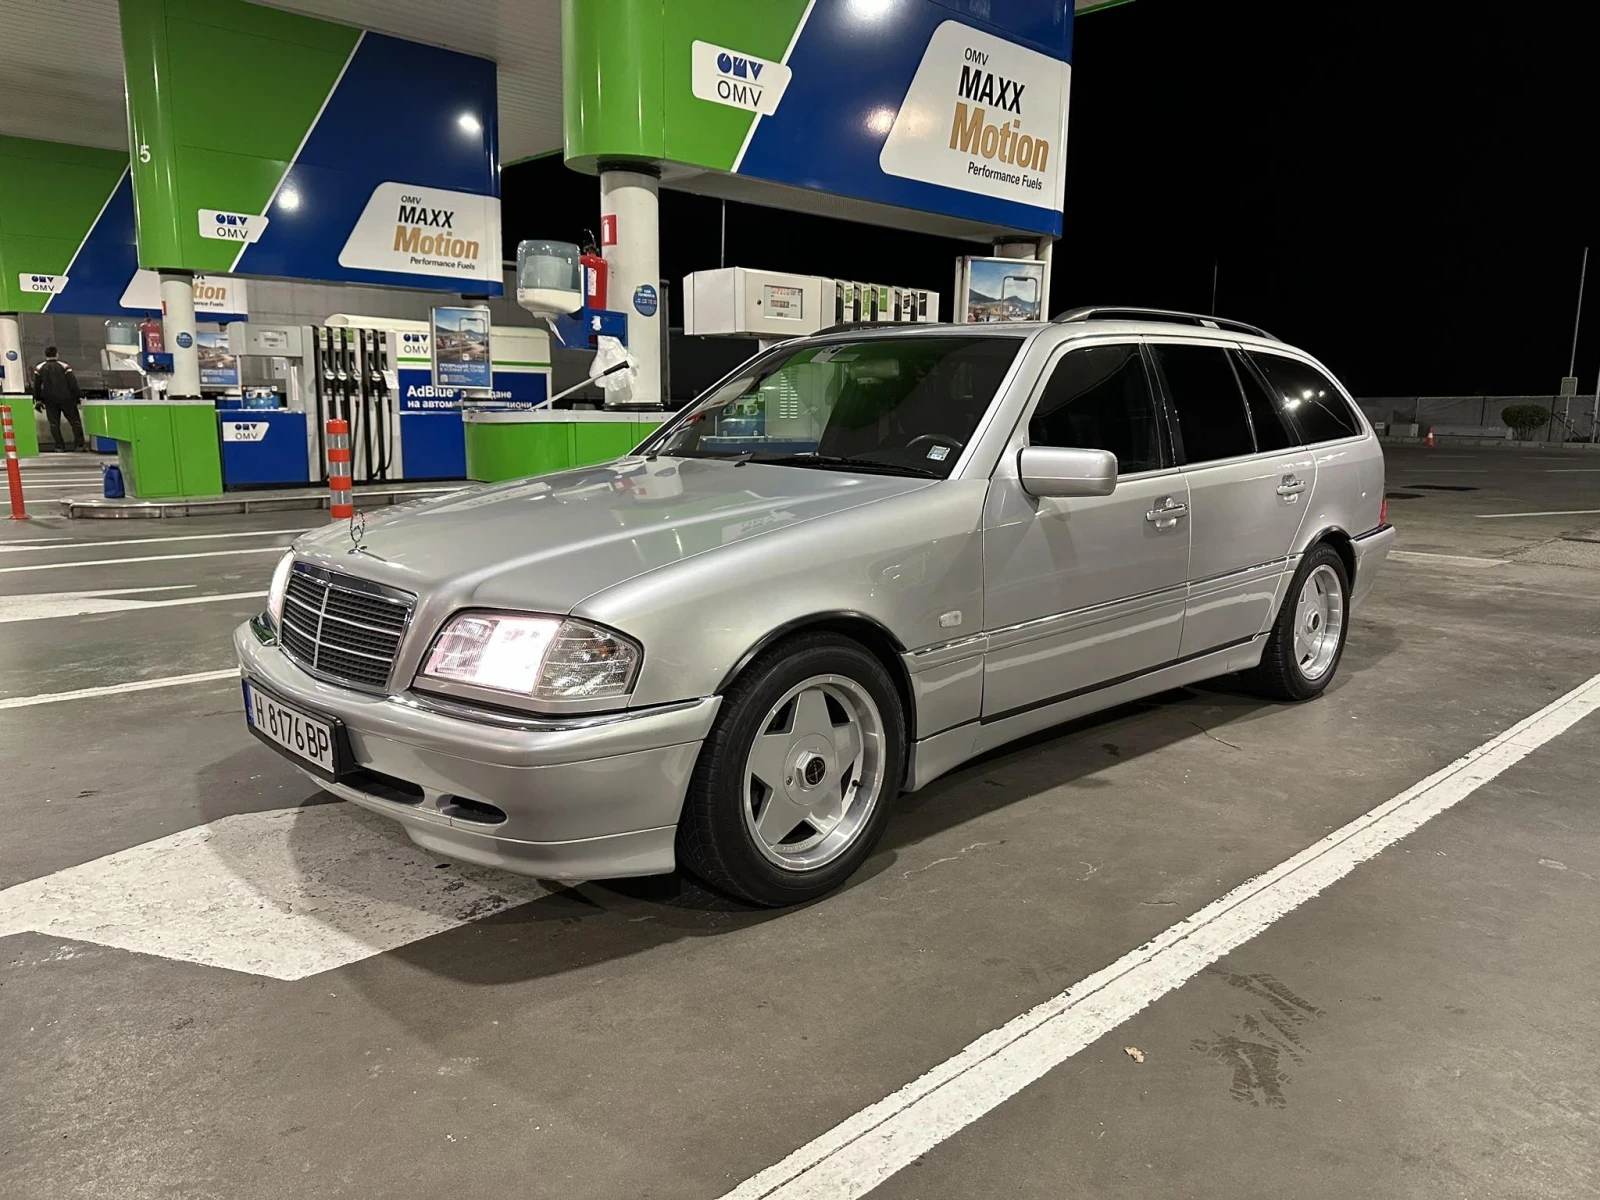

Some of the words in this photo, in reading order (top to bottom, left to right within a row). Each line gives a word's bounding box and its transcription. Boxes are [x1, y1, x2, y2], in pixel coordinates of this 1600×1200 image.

[964, 48, 989, 66] OMV
[717, 80, 762, 107] OMV
[958, 64, 1026, 114] MAXX
[949, 102, 1049, 172] Motion
[140, 145, 151, 162] 5
[968, 161, 1020, 186] Performance
[1022, 174, 1042, 190] Fuels
[400, 195, 422, 204] OMV
[398, 205, 454, 228] MAXX
[216, 227, 248, 239] OMV
[394, 225, 479, 260] Motion
[410, 257, 456, 268] Performance
[457, 262, 475, 270] Fuels
[192, 281, 226, 300] tion
[404, 344, 428, 354] OMV
[407, 400, 421, 408] на
[422, 400, 452, 408] автом
